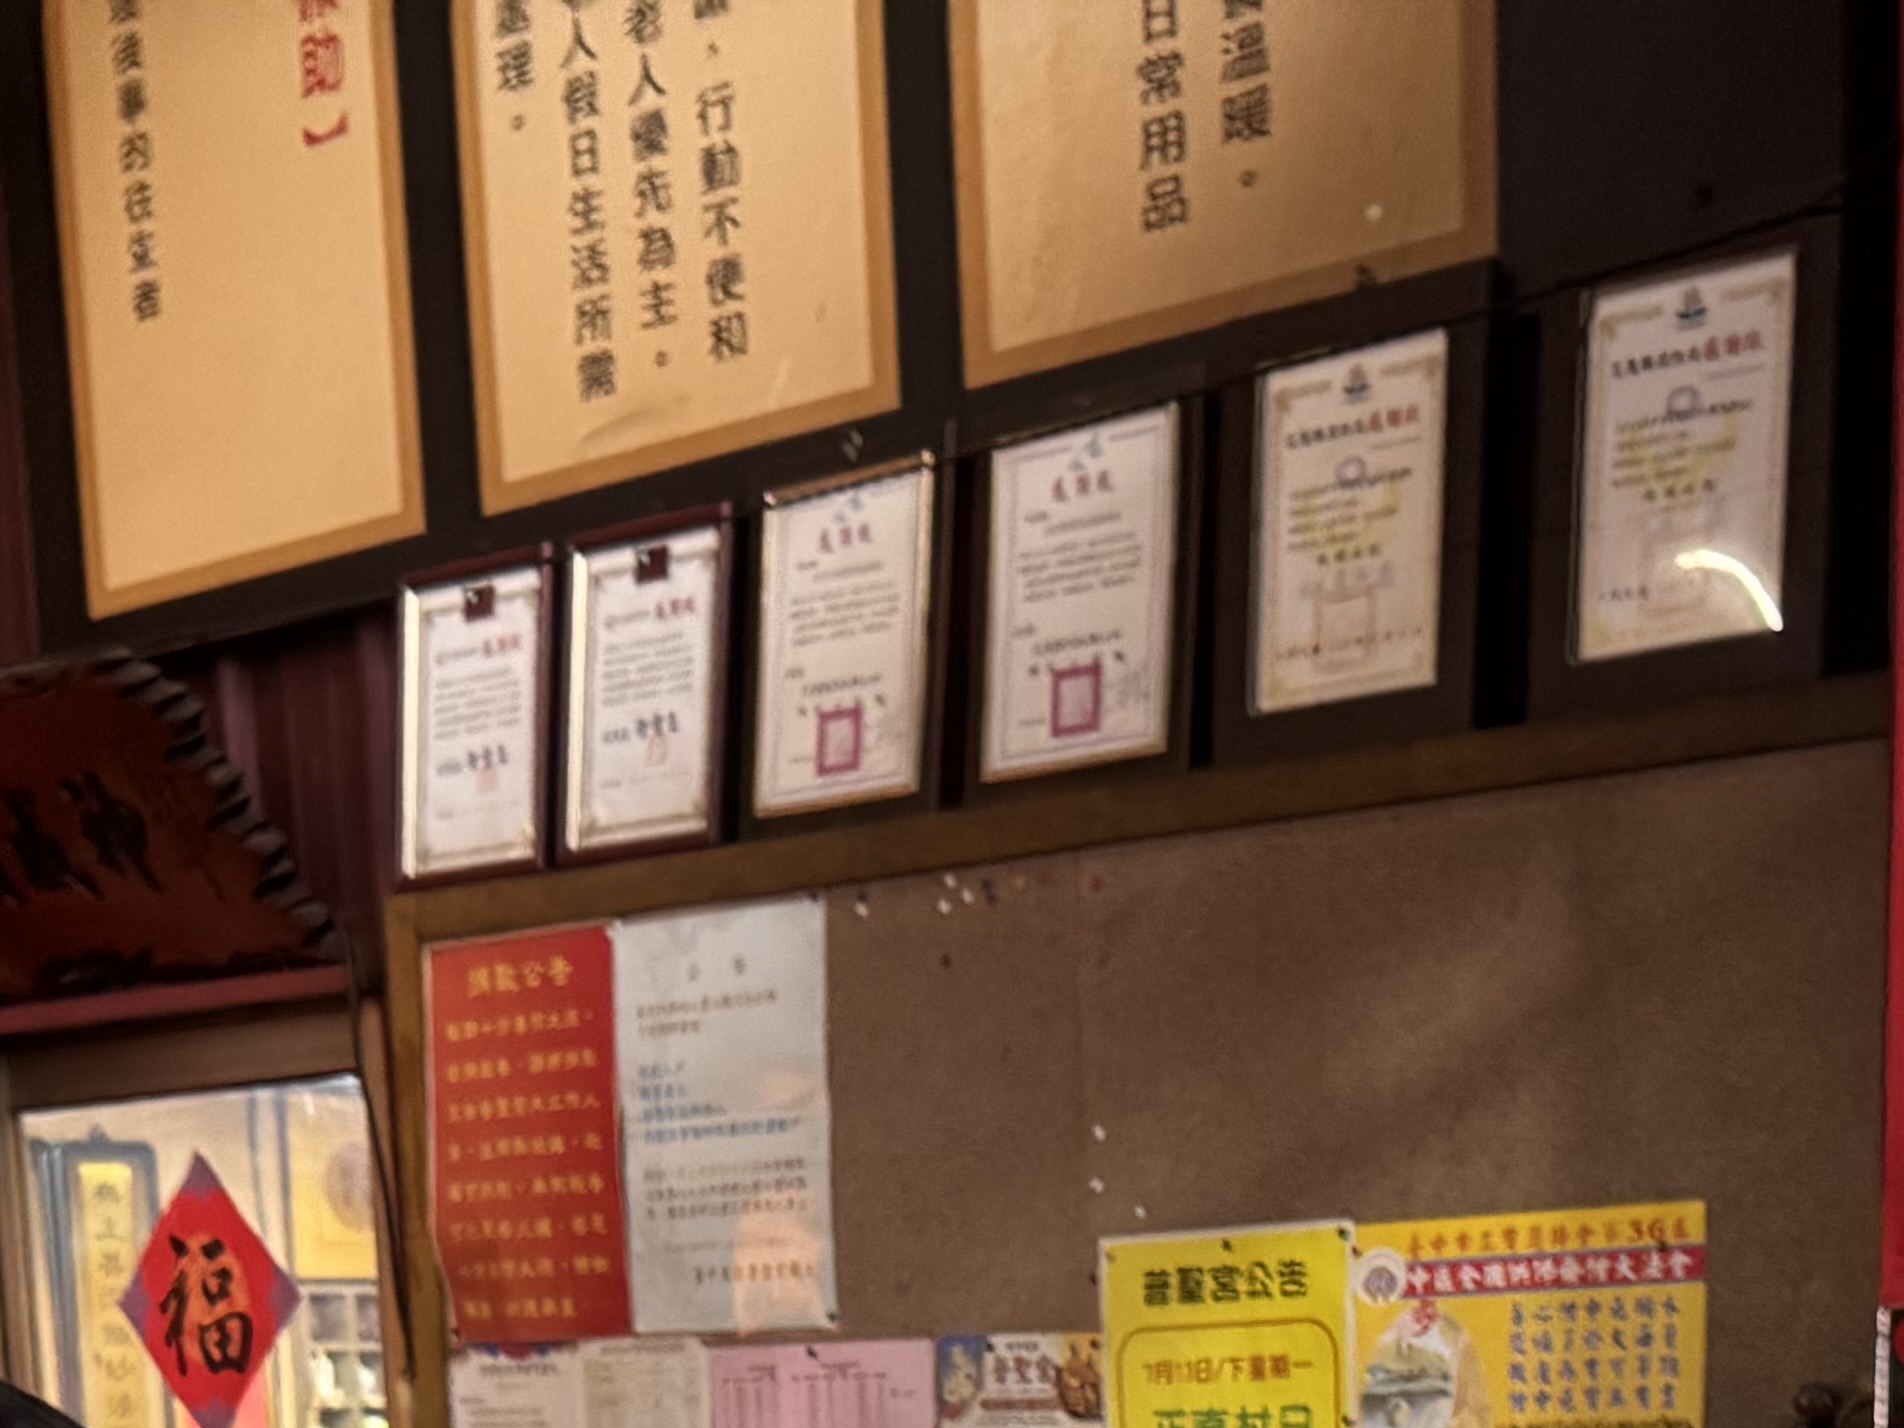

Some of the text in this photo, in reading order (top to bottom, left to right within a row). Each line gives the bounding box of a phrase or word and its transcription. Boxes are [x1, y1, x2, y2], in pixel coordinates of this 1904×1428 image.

[159, 1234, 254, 1378] 福
[1143, 1260, 1309, 1308] 普聖宮公告
